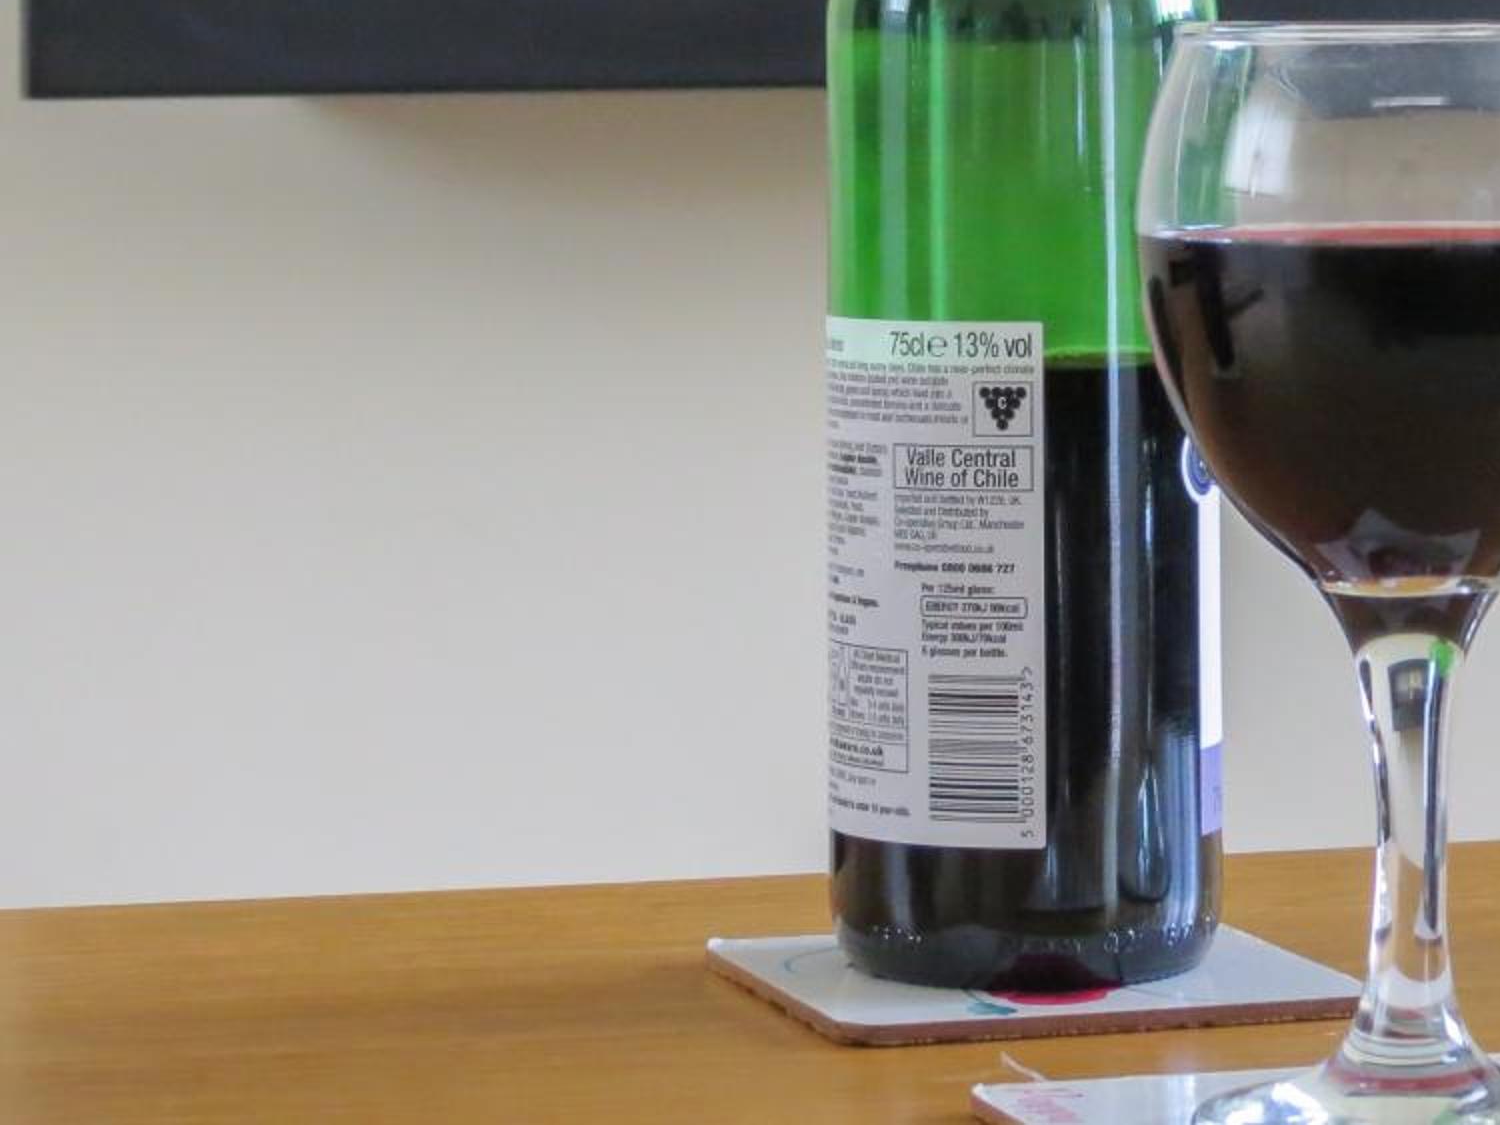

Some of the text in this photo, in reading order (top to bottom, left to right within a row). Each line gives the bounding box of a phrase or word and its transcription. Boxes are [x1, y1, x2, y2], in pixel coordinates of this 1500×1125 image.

[889, 331, 924, 356] 75cl
[953, 331, 999, 358] 13%
[1003, 332, 1032, 358] vol
[906, 446, 945, 467] Valle
[951, 448, 1016, 467] Central
[905, 466, 945, 486] Wine
[950, 469, 968, 487] of
[973, 468, 1019, 488] Chile
[1021, 754, 1034, 817] 000128
[1021, 830, 1034, 838] 5
